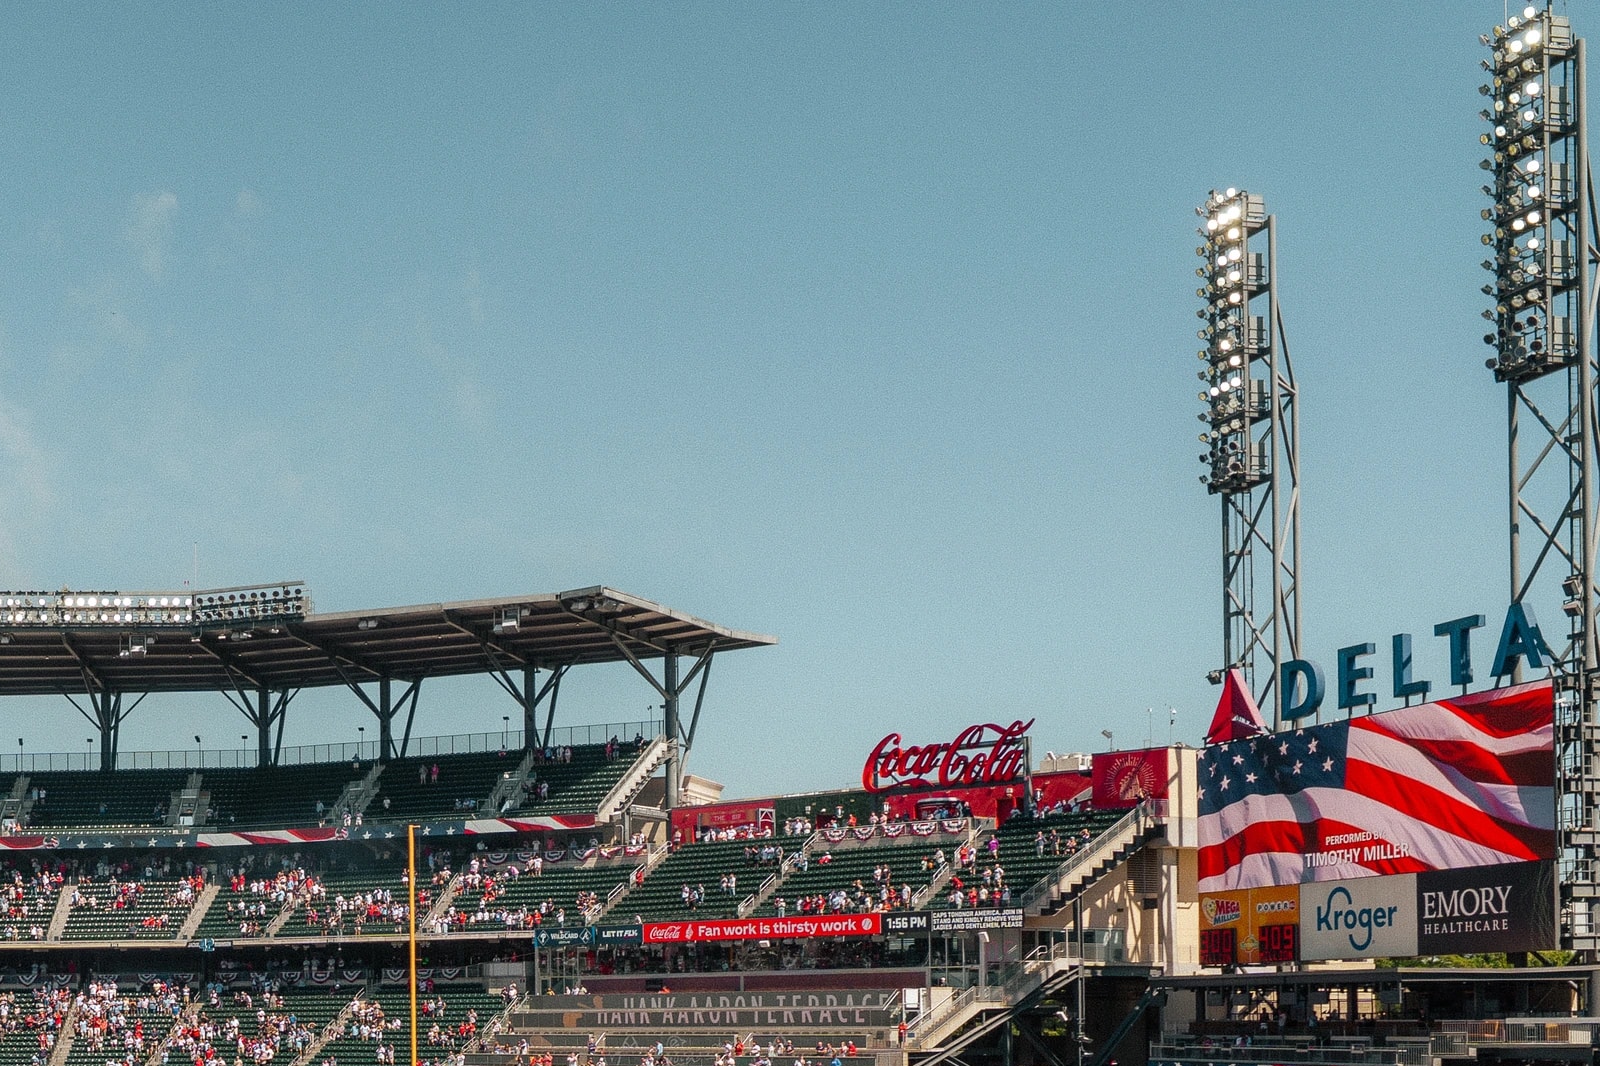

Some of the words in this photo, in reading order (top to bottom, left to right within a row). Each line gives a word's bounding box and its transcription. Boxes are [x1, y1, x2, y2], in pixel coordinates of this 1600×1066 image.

[1281, 602, 1550, 721] DELTA
[862, 718, 1035, 793] Coca-Cola
[1325, 832, 1372, 846] PERFORMED
[1305, 848, 1360, 868] TIMOTHY
[1363, 842, 1410, 863] MILLER
[1216, 900, 1240, 914] MEGA
[1422, 885, 1513, 920] EMORY
[698, 925, 720, 937] Fan
[723, 922, 757, 936] work
[759, 922, 770, 934] is
[773, 921, 817, 936] thirsty
[820, 919, 857, 932] work
[886, 917, 908, 930] 1:56
[909, 916, 927, 928] PM
[1317, 886, 1398, 951] Kroger
[1423, 919, 1509, 934] HEALTHCARE
